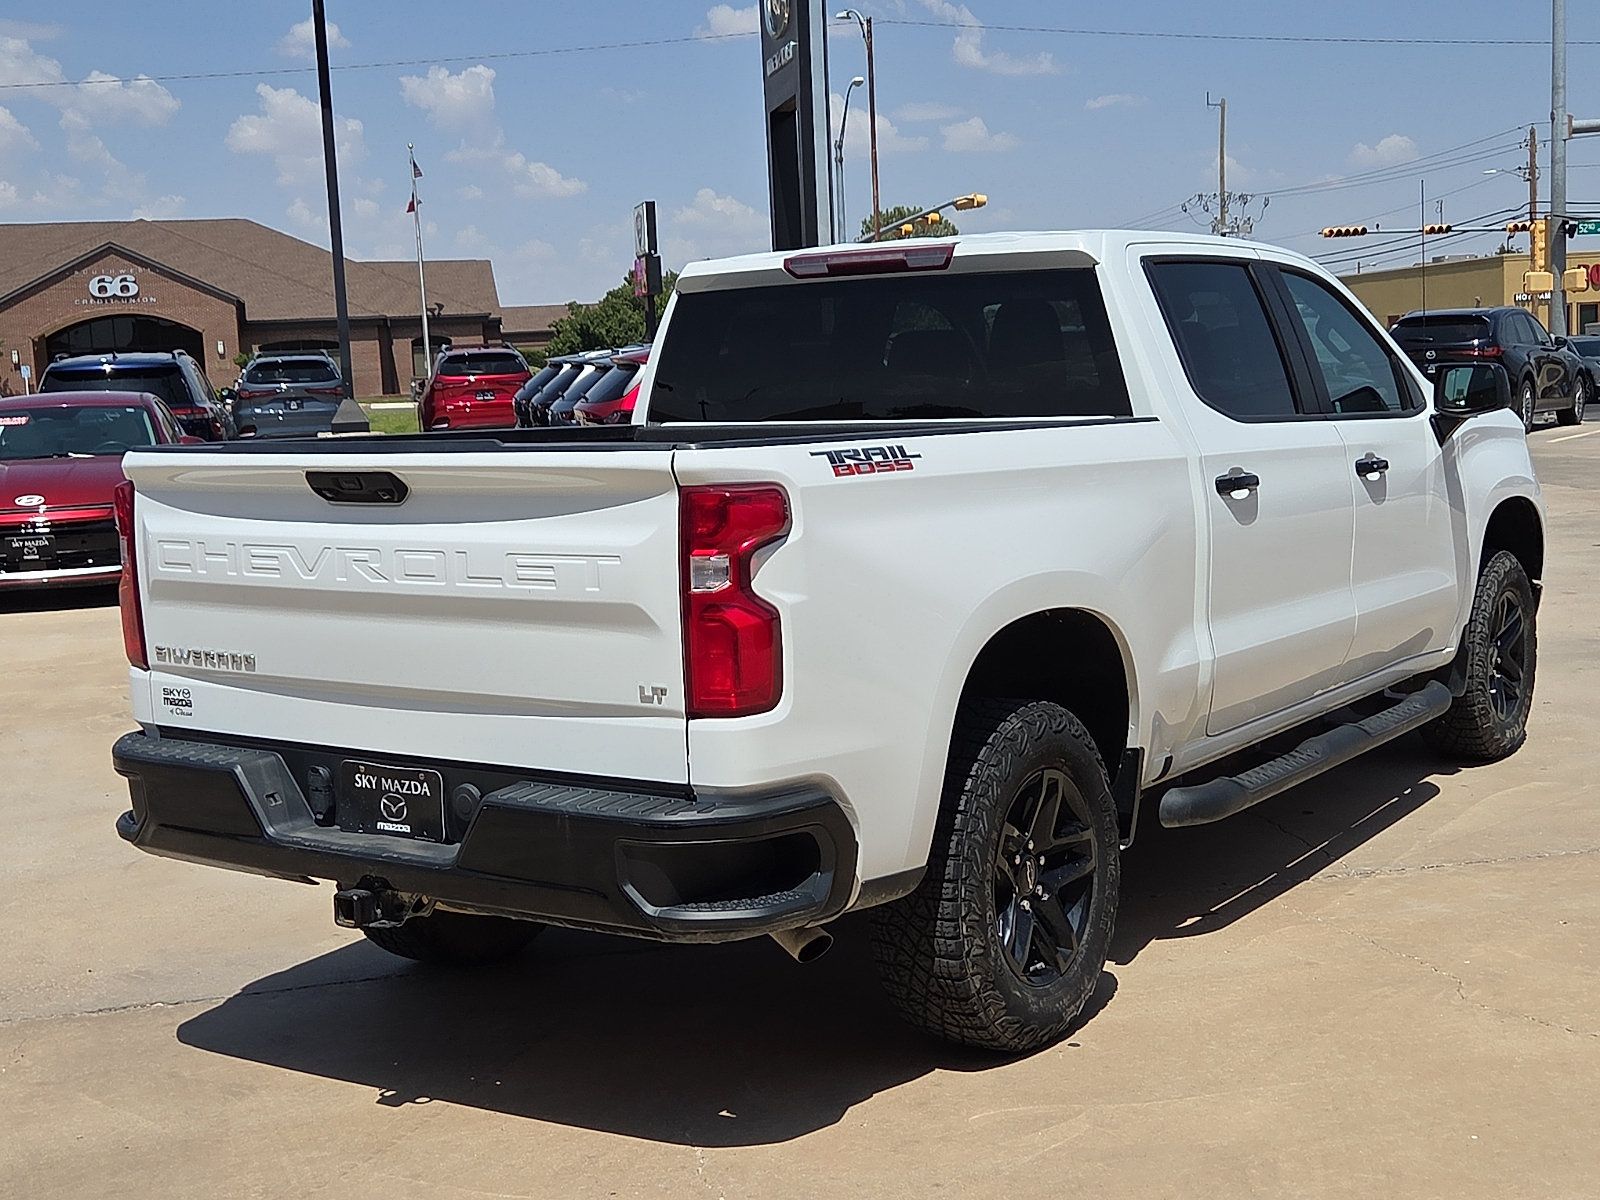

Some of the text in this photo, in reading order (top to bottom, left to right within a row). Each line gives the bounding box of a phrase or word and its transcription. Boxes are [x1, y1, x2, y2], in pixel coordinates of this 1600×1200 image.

[88, 274, 139, 298] 66
[809, 445, 922, 465] TRAIL
[832, 459, 914, 477] BOSS
[157, 539, 622, 593] CHEVROLET
[162, 687, 182, 697] SKY
[639, 685, 668, 705] LT
[354, 773, 431, 797] SKY MAZDA
